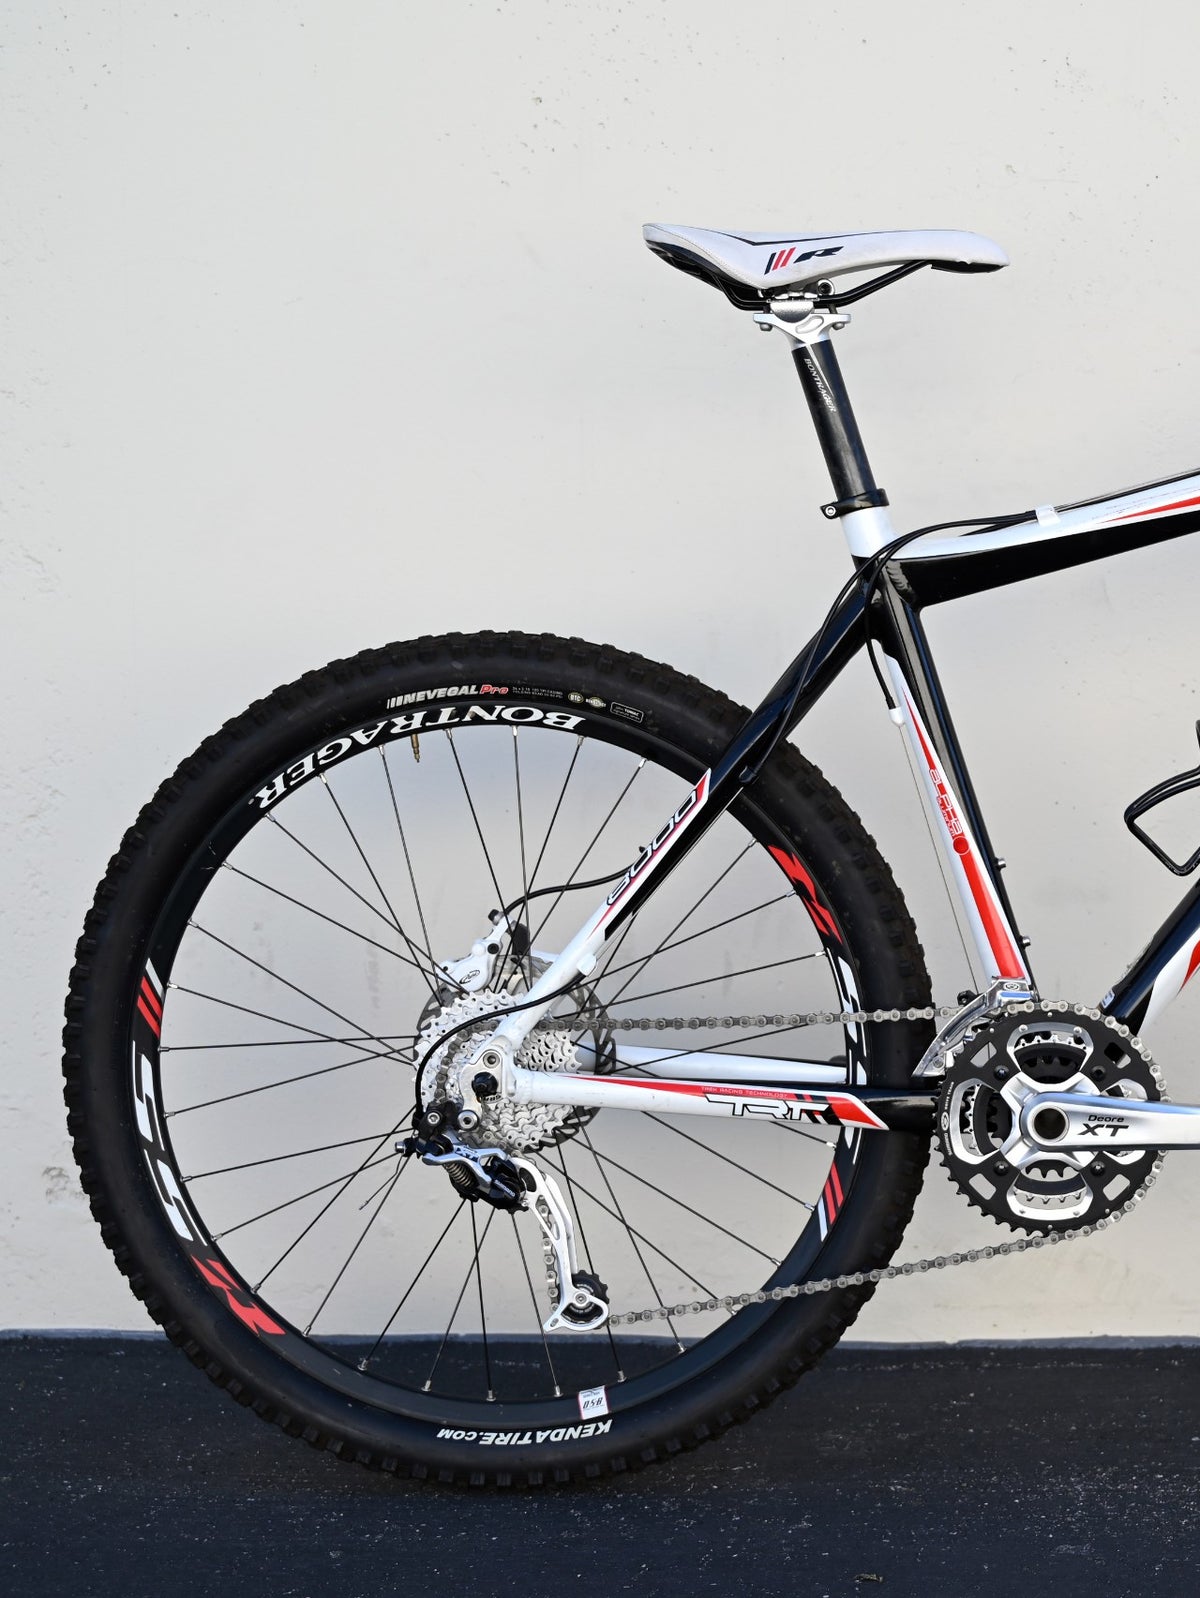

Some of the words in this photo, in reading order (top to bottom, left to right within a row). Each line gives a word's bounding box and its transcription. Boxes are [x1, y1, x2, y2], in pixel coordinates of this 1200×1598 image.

[803, 357, 837, 413] BONTRAGER
[402, 685, 479, 705] NEVEGAL
[480, 684, 509, 695] Pro
[255, 705, 587, 810] BONTRAGER
[1078, 1122, 1130, 1137] XT
[1088, 1114, 1125, 1123] Deore
[436, 1419, 613, 1446] KENDATIRE.COM
